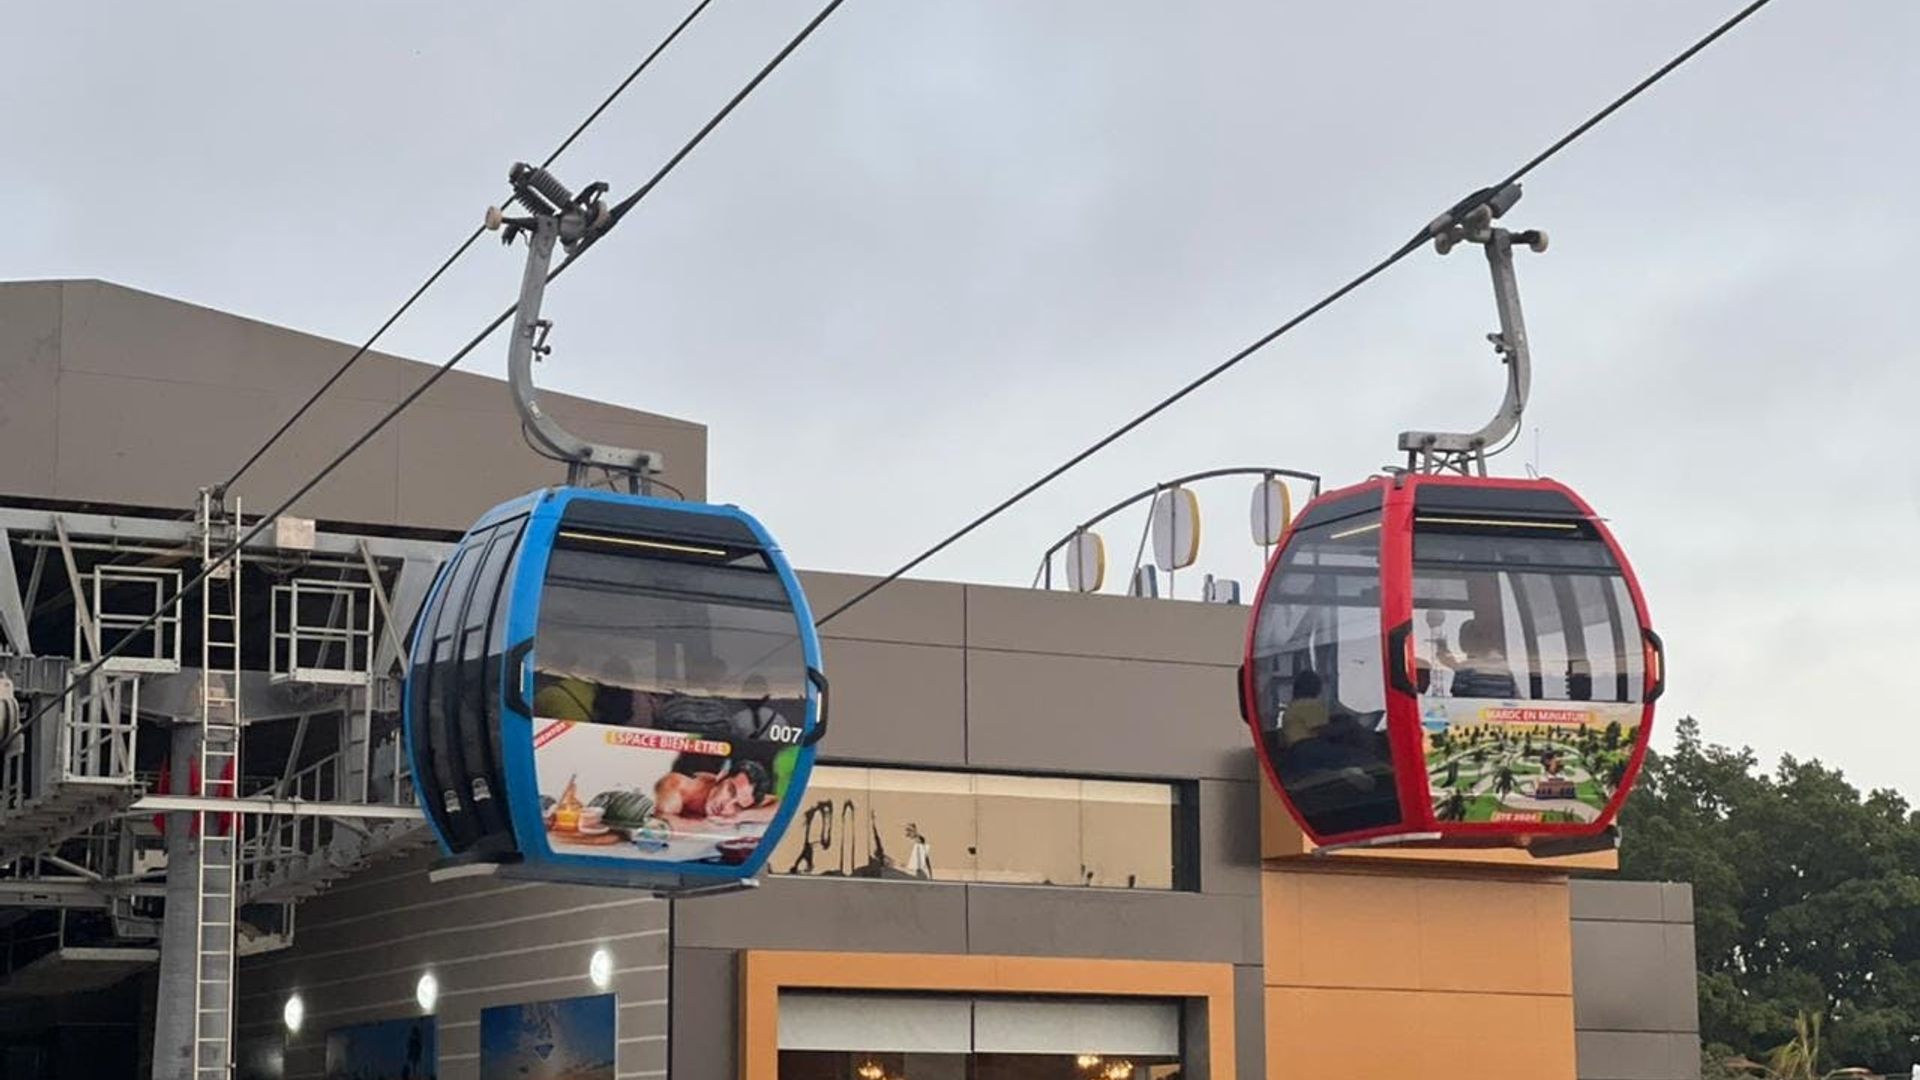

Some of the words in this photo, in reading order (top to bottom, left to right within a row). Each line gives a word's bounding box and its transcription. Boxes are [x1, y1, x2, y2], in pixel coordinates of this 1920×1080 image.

[1486, 710, 1521, 721] MAROC
[1523, 710, 1537, 721] EN
[611, 731, 657, 748] ESPACE
[769, 724, 803, 744] 007
